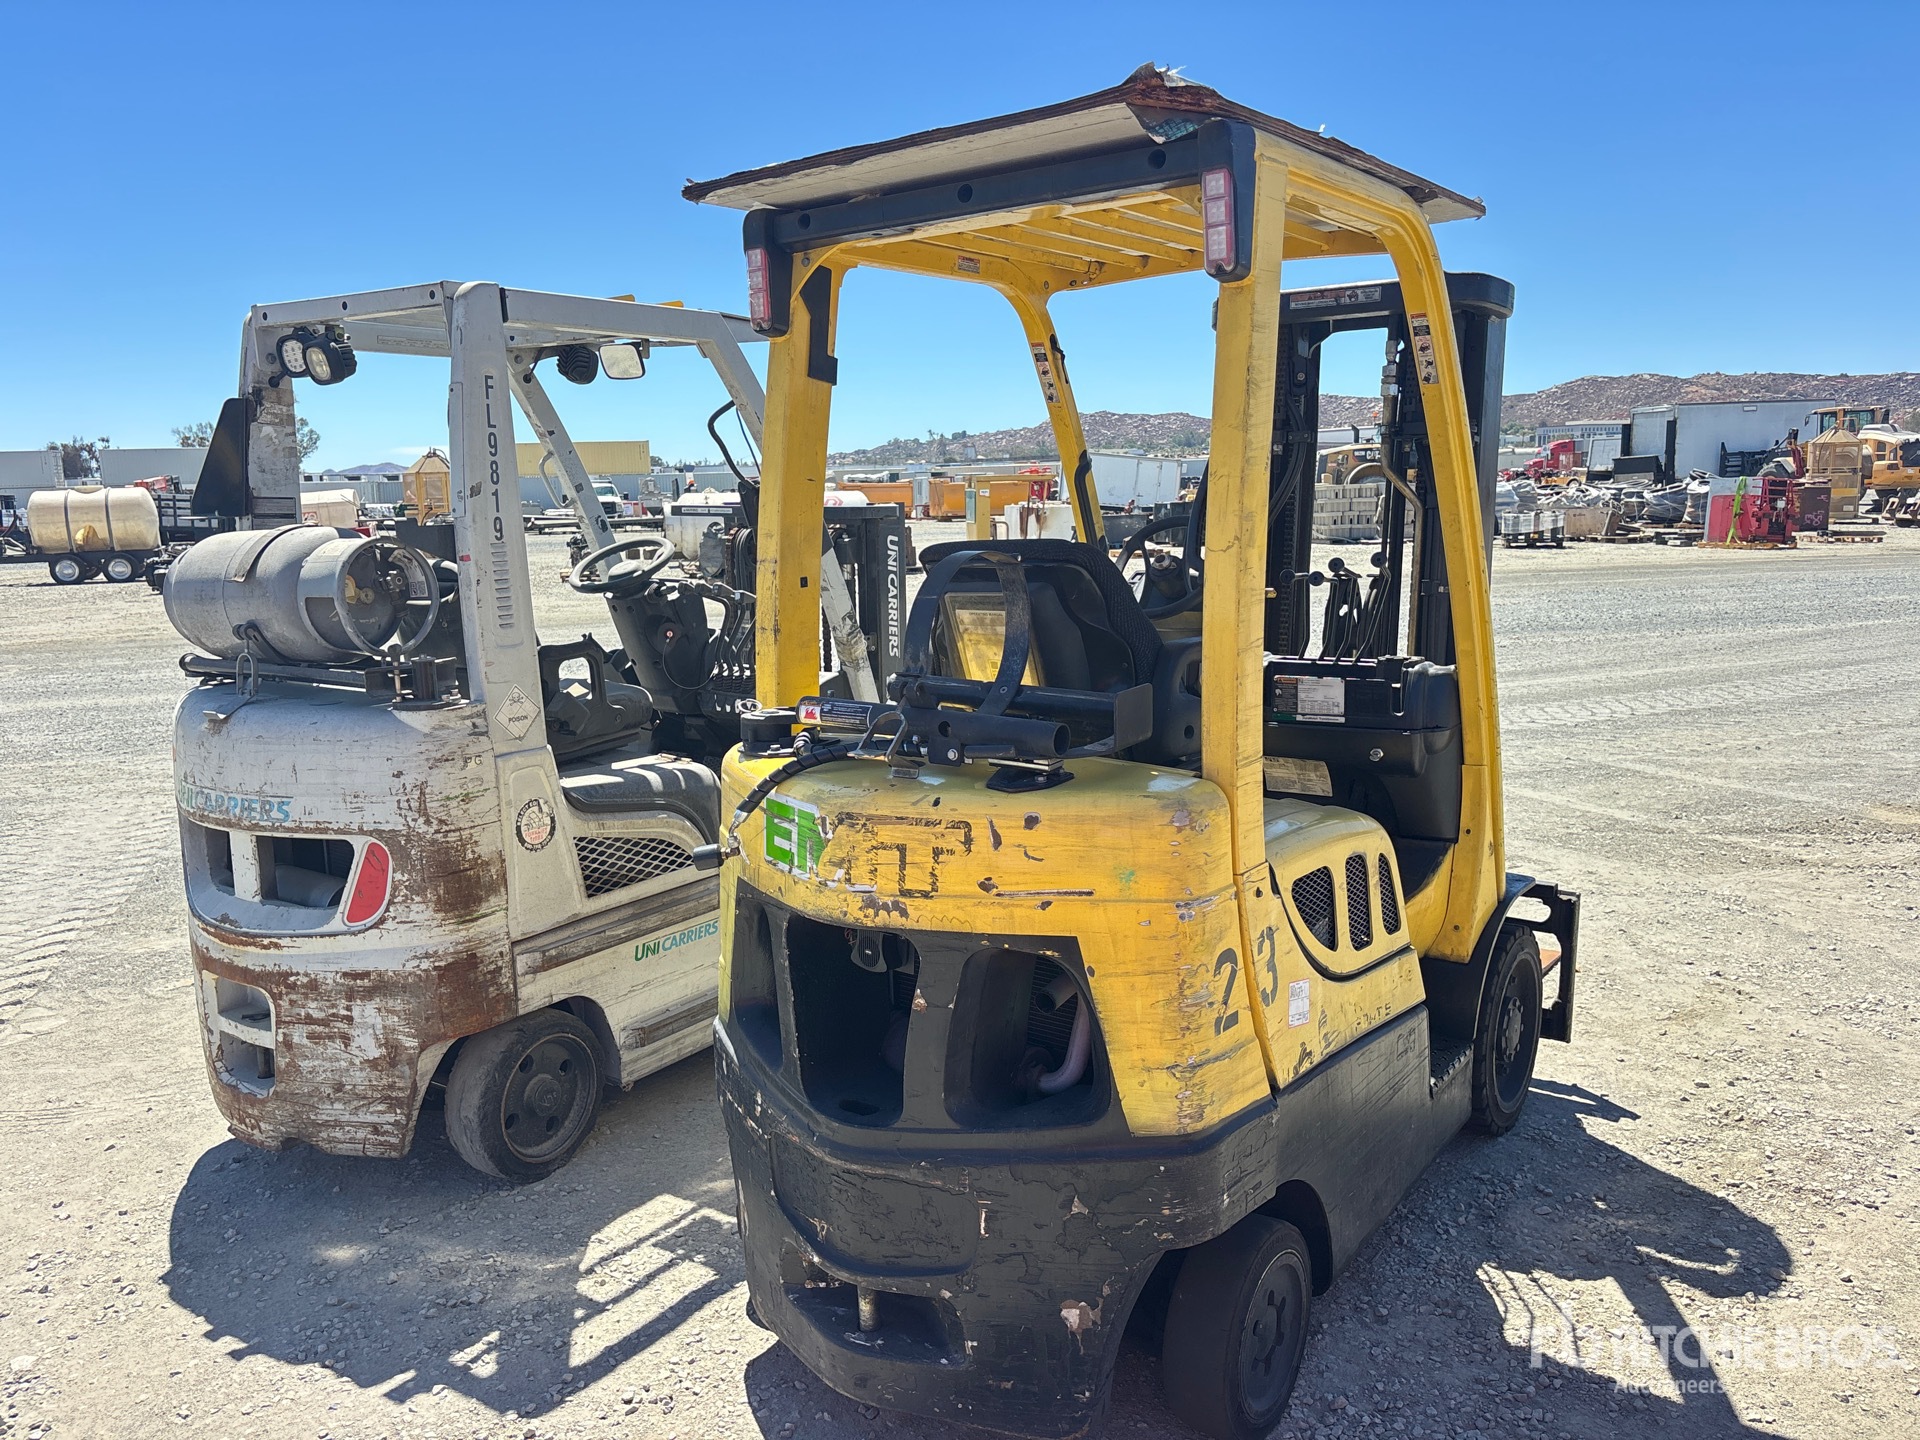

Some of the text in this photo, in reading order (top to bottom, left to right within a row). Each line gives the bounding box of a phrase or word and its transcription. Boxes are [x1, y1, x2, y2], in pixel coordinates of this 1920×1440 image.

[484, 375, 505, 543] FL9819
[886, 534, 900, 659] UNICARRIERS
[508, 715, 529, 724] POISON
[634, 920, 719, 962] UNICARRIERS
